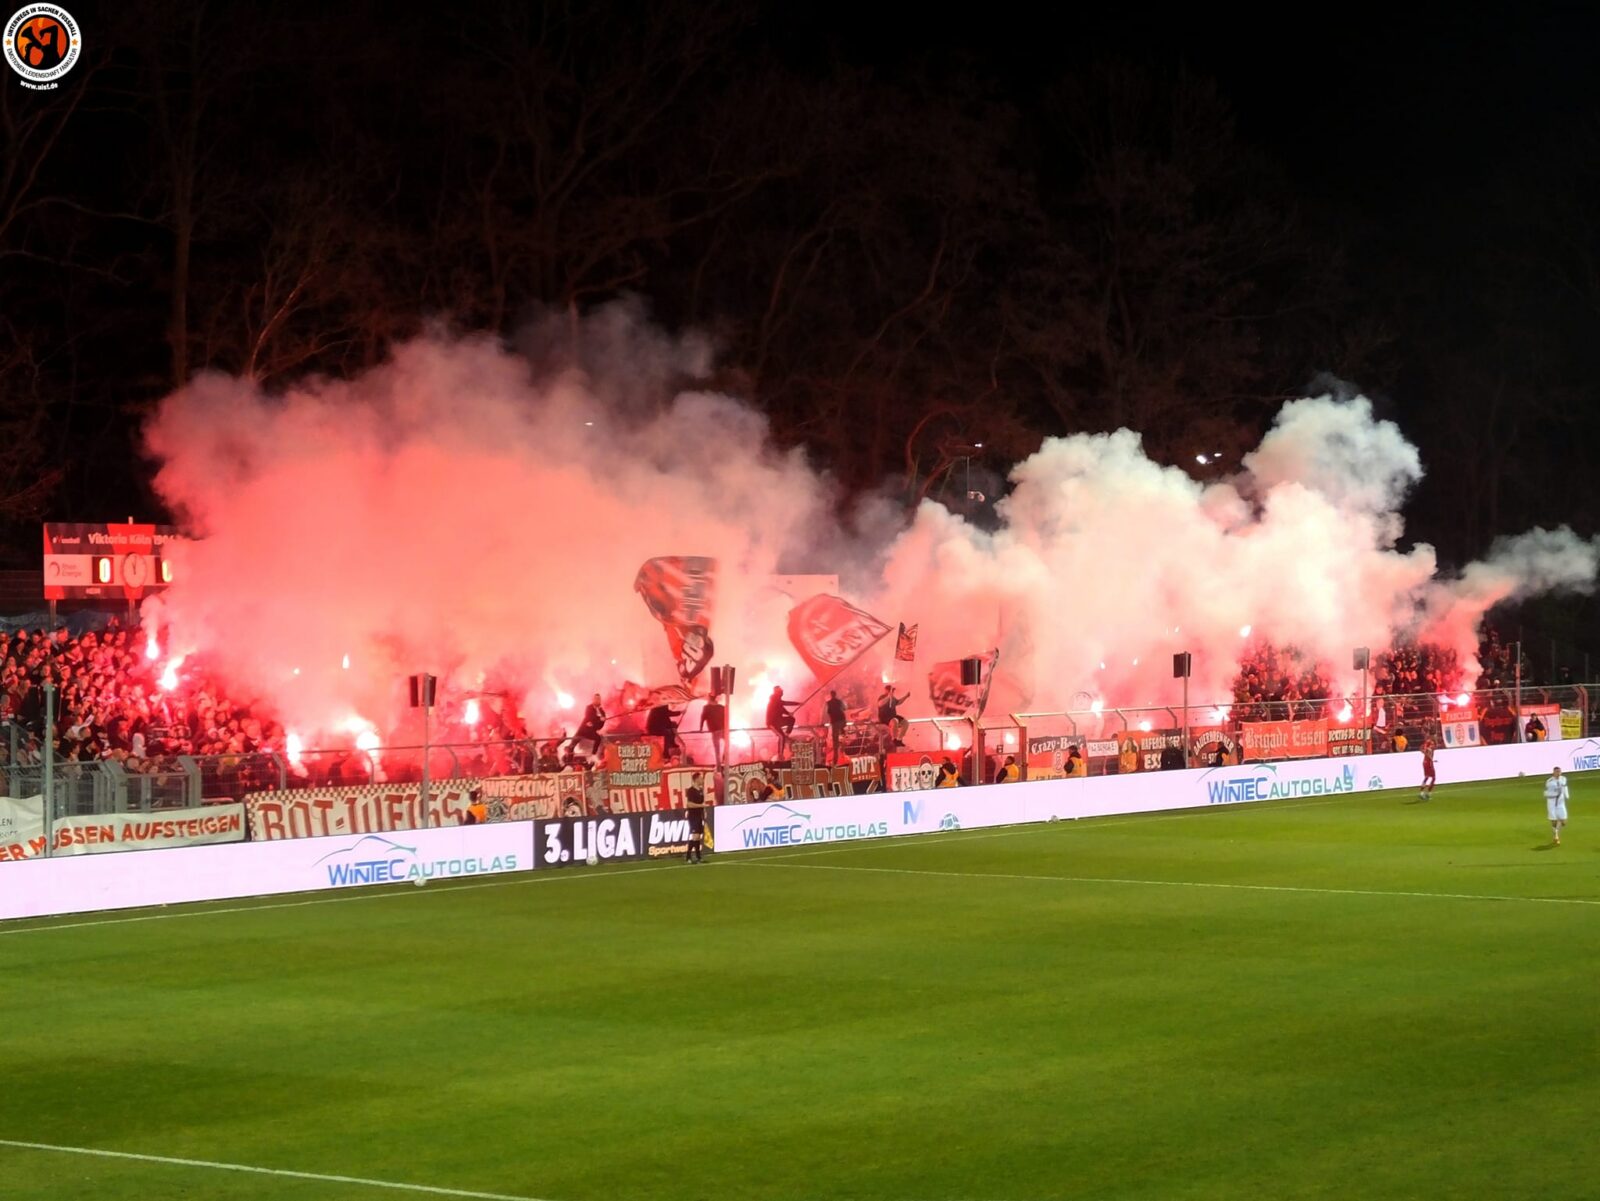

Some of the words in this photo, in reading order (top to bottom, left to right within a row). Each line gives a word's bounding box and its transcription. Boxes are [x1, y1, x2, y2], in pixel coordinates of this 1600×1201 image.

[88, 532, 127, 544] Viktoria
[129, 533, 151, 544] Köln
[1245, 728, 1289, 753] Brigade
[1292, 726, 1325, 746] Essen
[1269, 774, 1354, 797] AUTOGLAS
[121, 814, 241, 841] AUFSTEIGEN
[648, 814, 692, 844] bwi
[803, 822, 888, 842] AUTOGLAS
[544, 824, 570, 863] 3.
[573, 818, 635, 860] LIGA
[407, 855, 517, 879] AUTOGLAS
